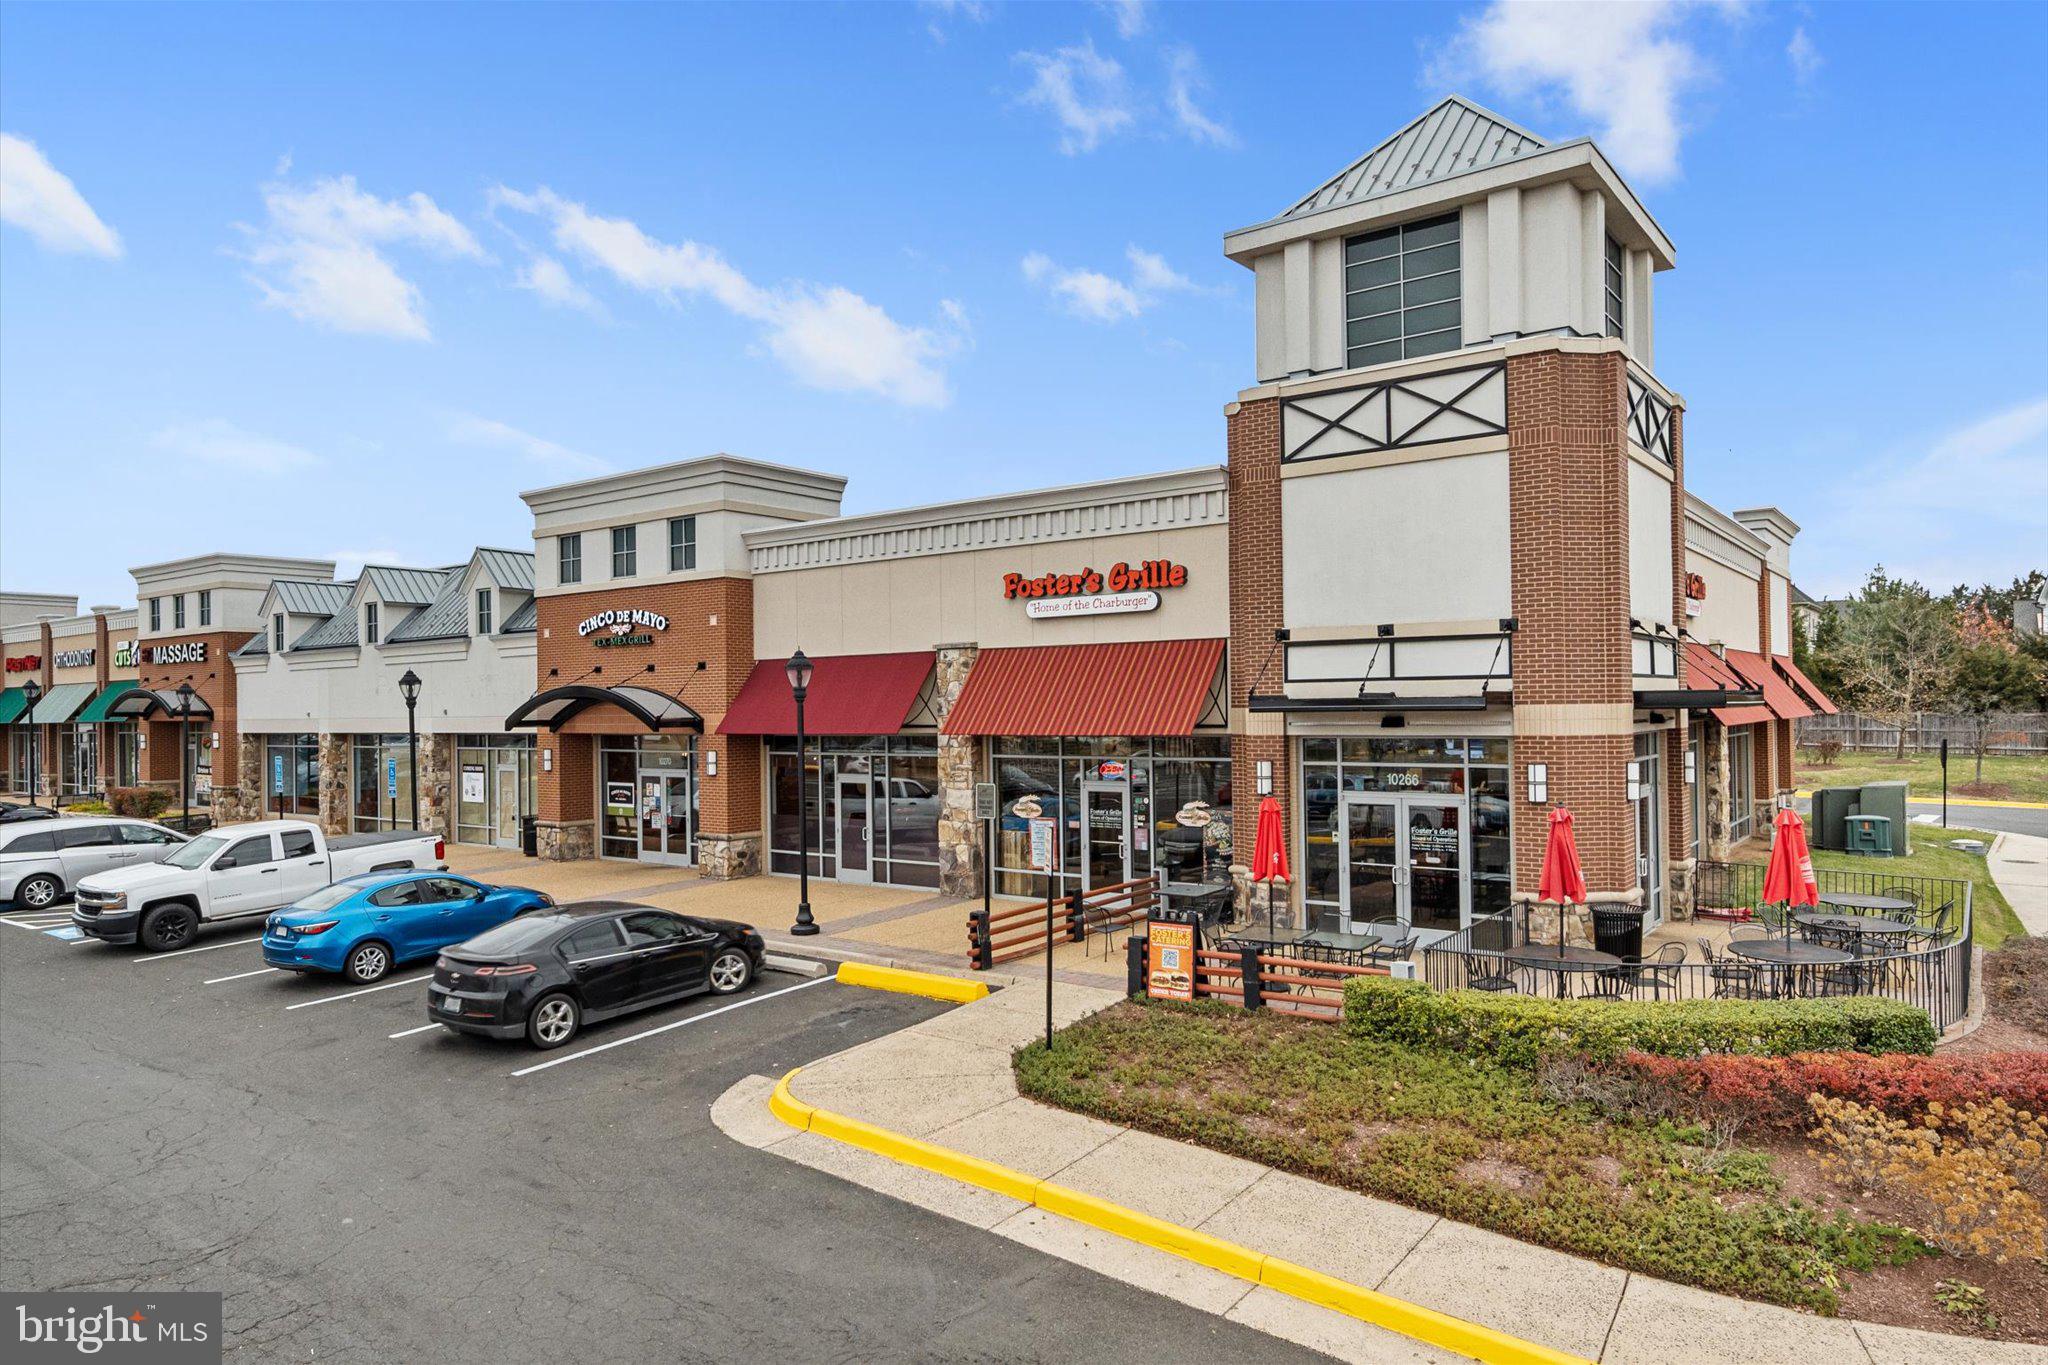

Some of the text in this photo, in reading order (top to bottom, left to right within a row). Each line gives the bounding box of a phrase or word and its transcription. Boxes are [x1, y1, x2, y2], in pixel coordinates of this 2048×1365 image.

[1003, 559, 1186, 599] Foster's Grille
[1062, 600, 1073, 611] of
[1075, 598, 1090, 610] the
[578, 609, 666, 636] CINCO DE MAYO
[628, 635, 650, 645] GRILL
[115, 650, 131, 667] CUTS
[153, 643, 204, 665] MASSAGE
[1387, 773, 1419, 786] 10266
[1411, 826, 1457, 836] Foster's Grille
[1151, 928, 1191, 939] FOSTER'S
[1151, 935, 1191, 946] CATERING
